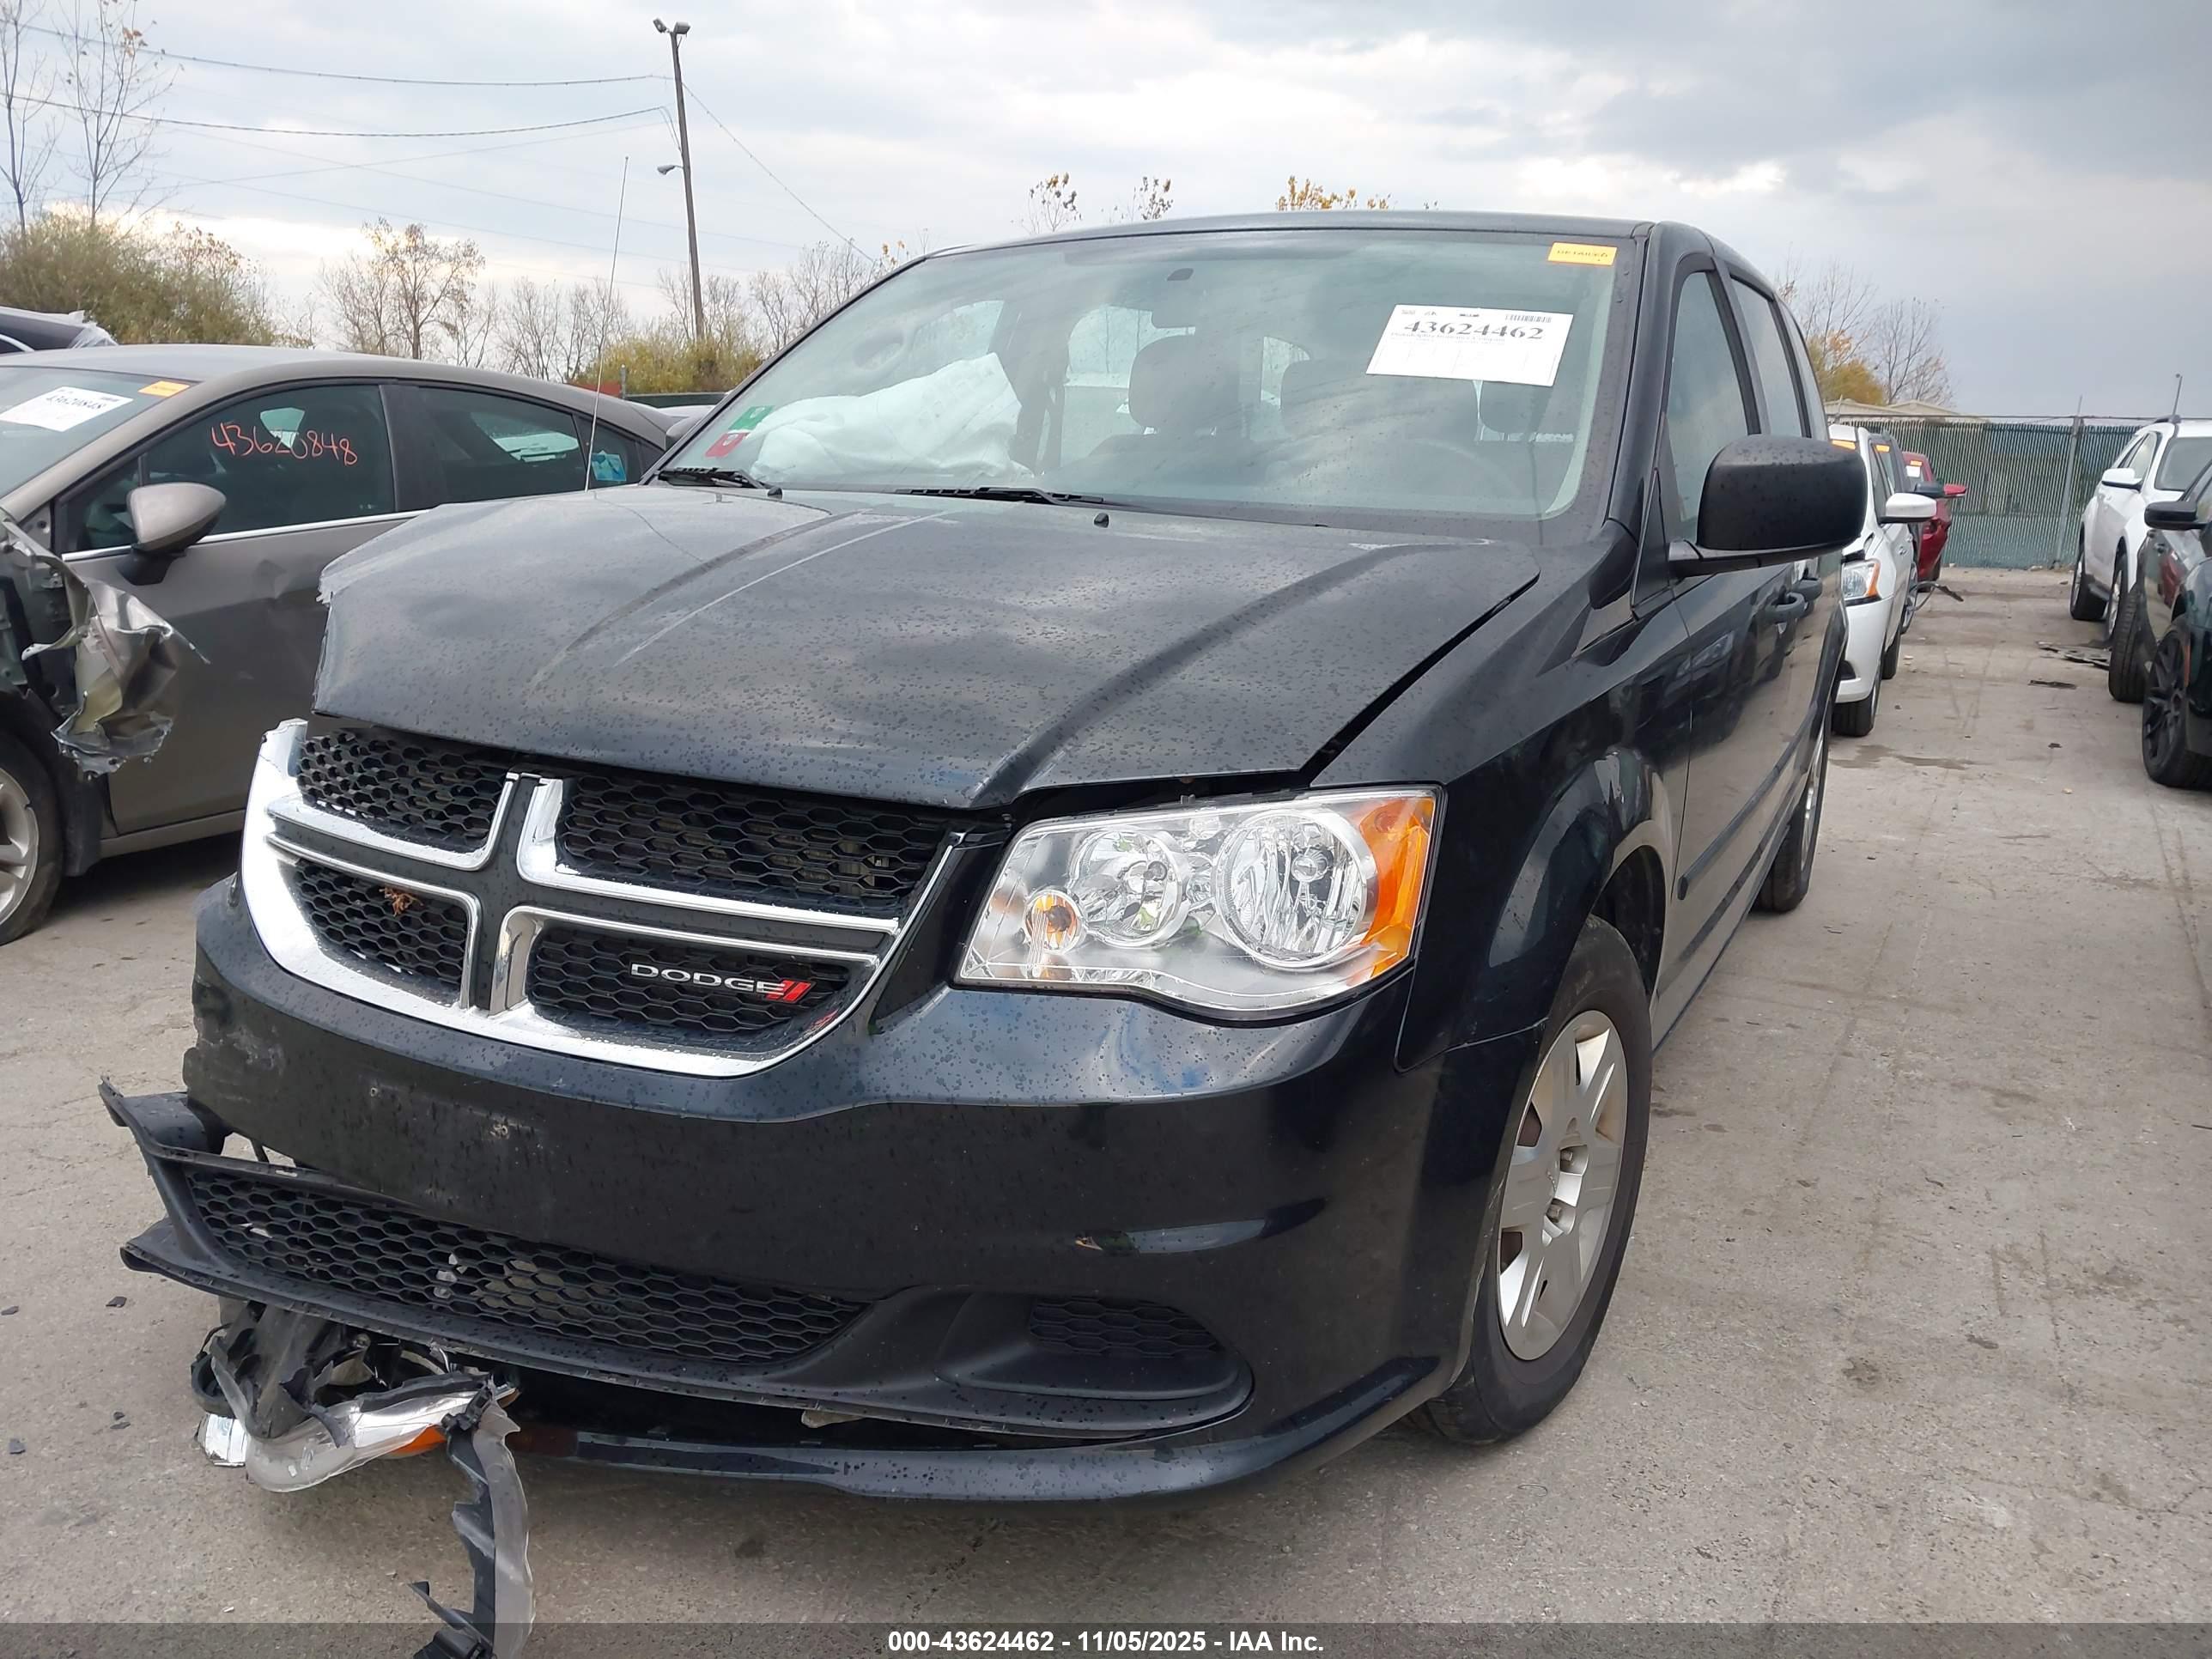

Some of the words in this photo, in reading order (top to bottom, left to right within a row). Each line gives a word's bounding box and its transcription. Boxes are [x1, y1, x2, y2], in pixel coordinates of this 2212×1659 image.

[1404, 319, 1545, 340] 43624462
[211, 422, 358, 466] 43620848
[630, 963, 786, 996] DODGE
